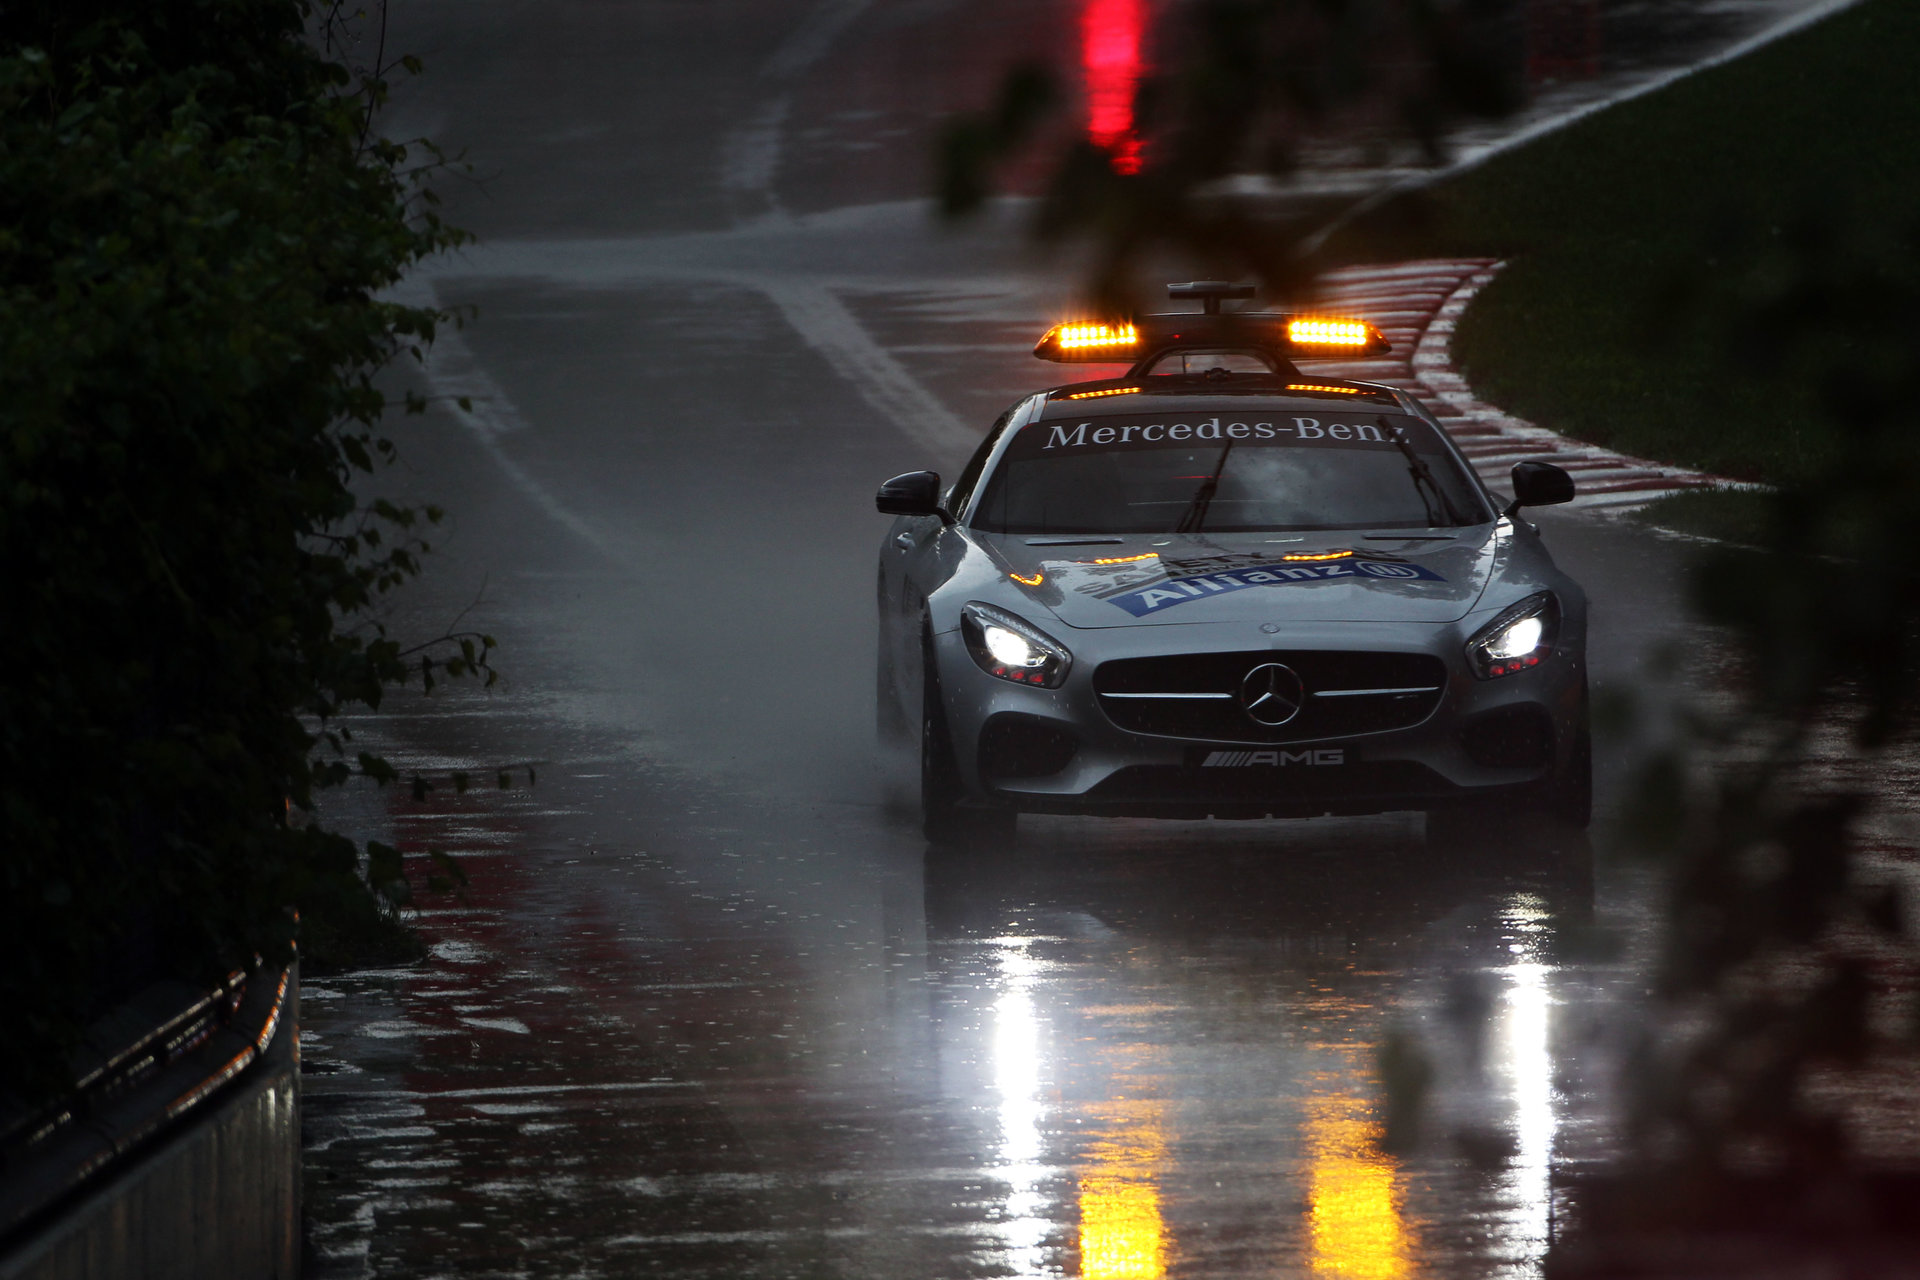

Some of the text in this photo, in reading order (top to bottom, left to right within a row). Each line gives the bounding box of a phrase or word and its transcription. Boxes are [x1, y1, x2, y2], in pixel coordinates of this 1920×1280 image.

[1042, 417, 1410, 449] Mercedes-Benz
[1134, 564, 1354, 609] Allianz
[1243, 748, 1345, 767] AMG
